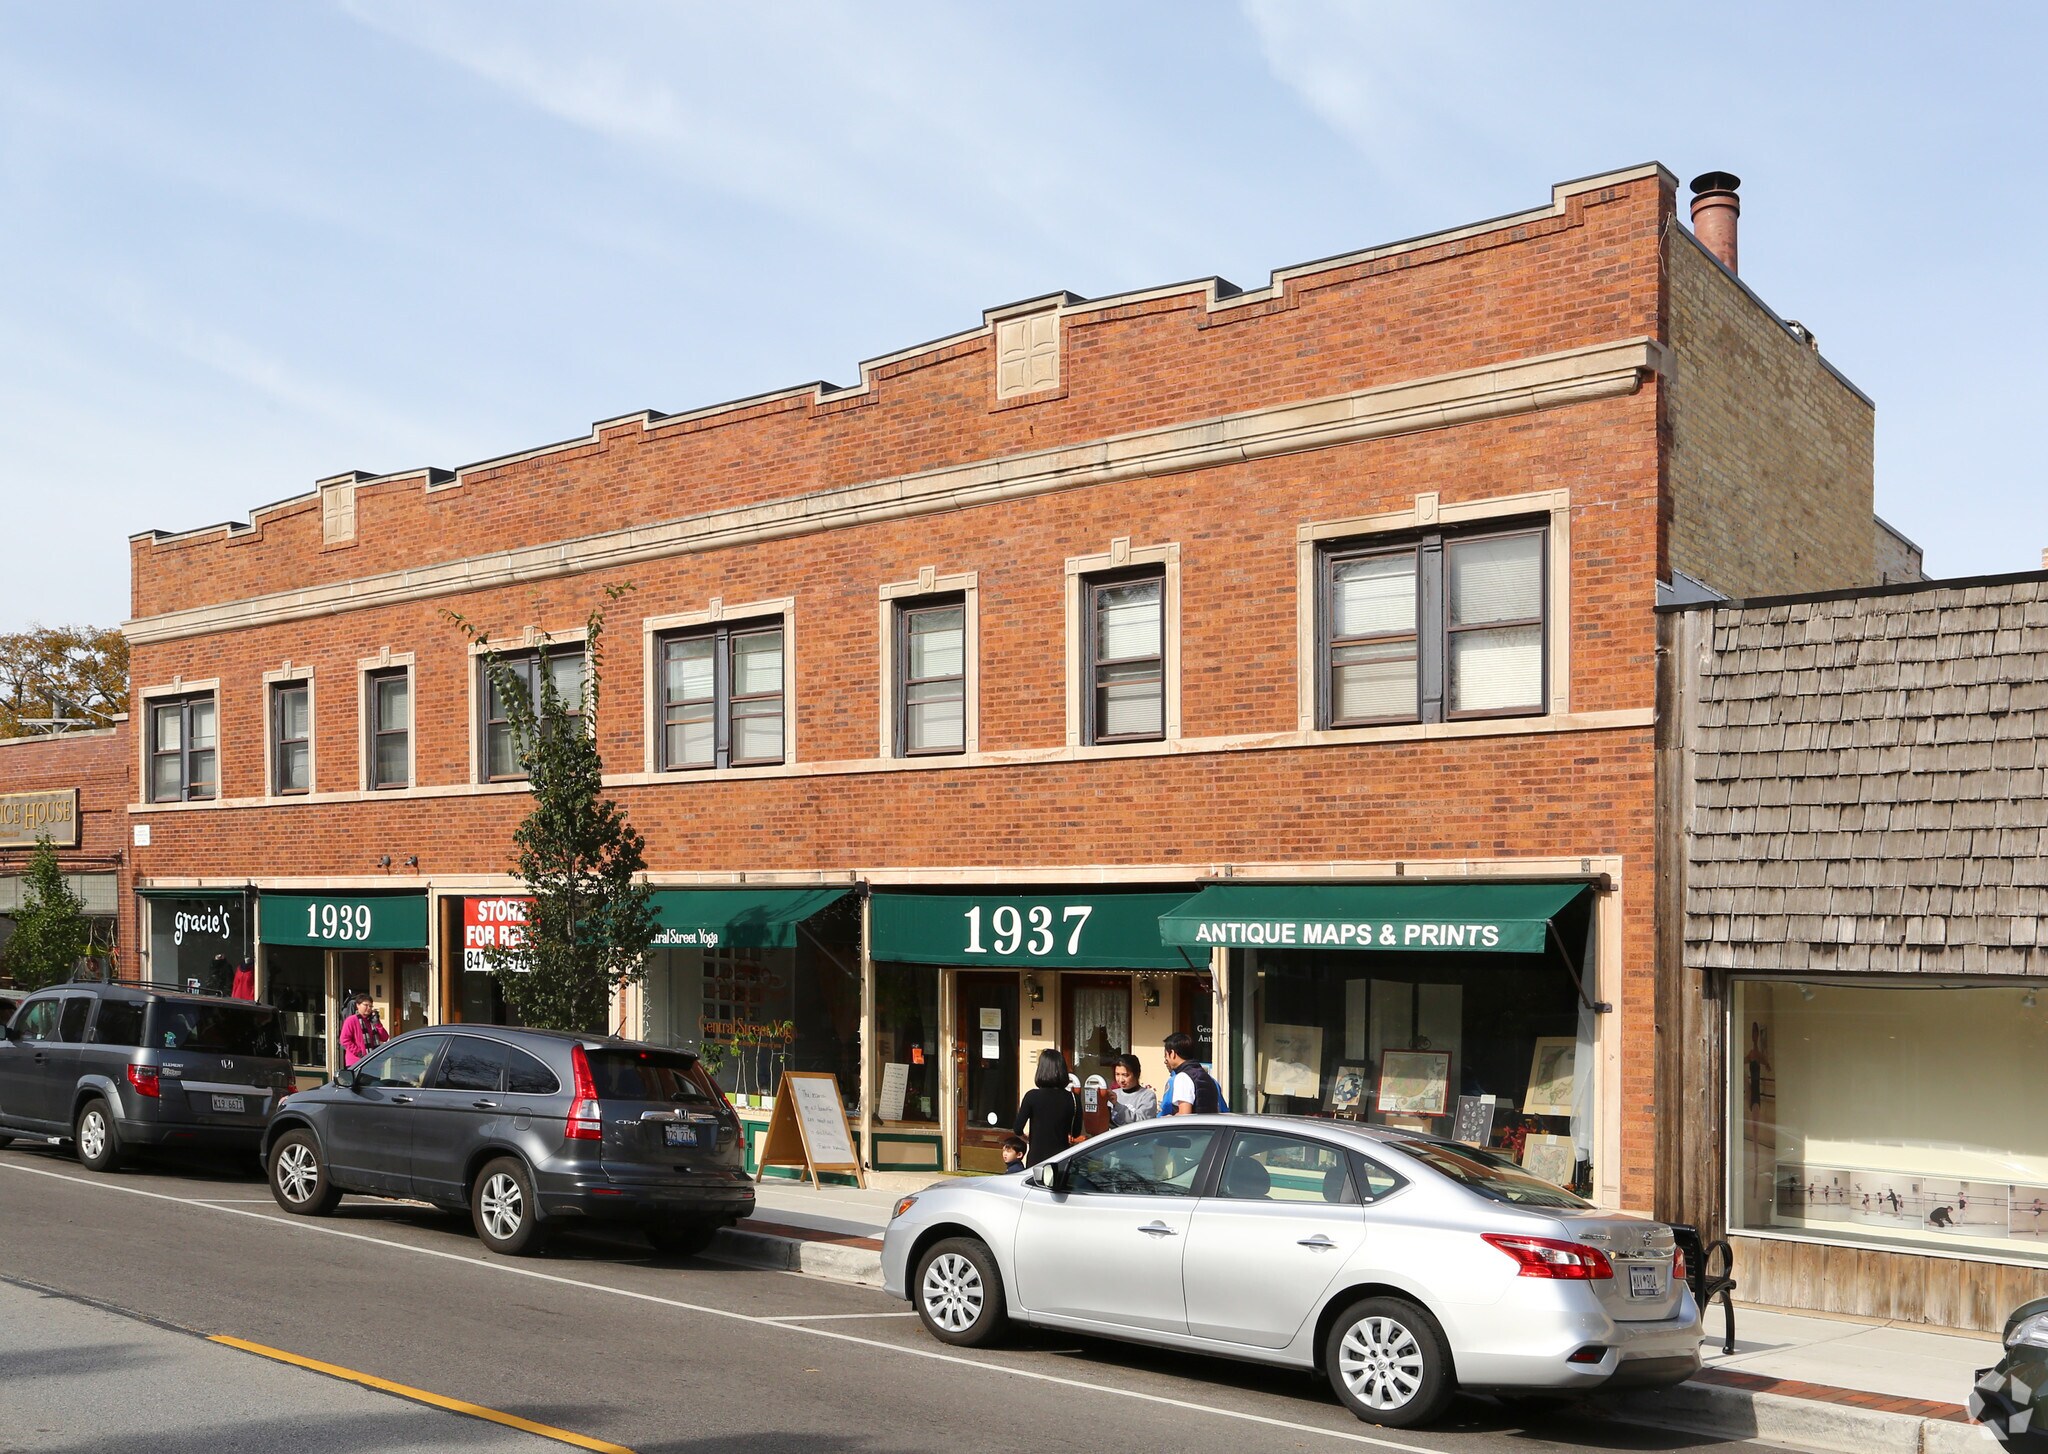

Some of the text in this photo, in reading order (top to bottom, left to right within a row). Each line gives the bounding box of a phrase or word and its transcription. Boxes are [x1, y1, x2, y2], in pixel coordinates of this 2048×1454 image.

[25, 800, 72, 830] HOUSE
[174, 904, 230, 945] gracie's
[307, 904, 371, 940] 1939
[964, 905, 1093, 955] 1937
[466, 925, 495, 946] FOR
[670, 928, 698, 944] Street
[698, 928, 719, 949] Yoga
[1195, 923, 1499, 947] ANTIQUE MAPS & PRINTS
[697, 1015, 736, 1036] Central
[1196, 1024, 1213, 1033] Geo
